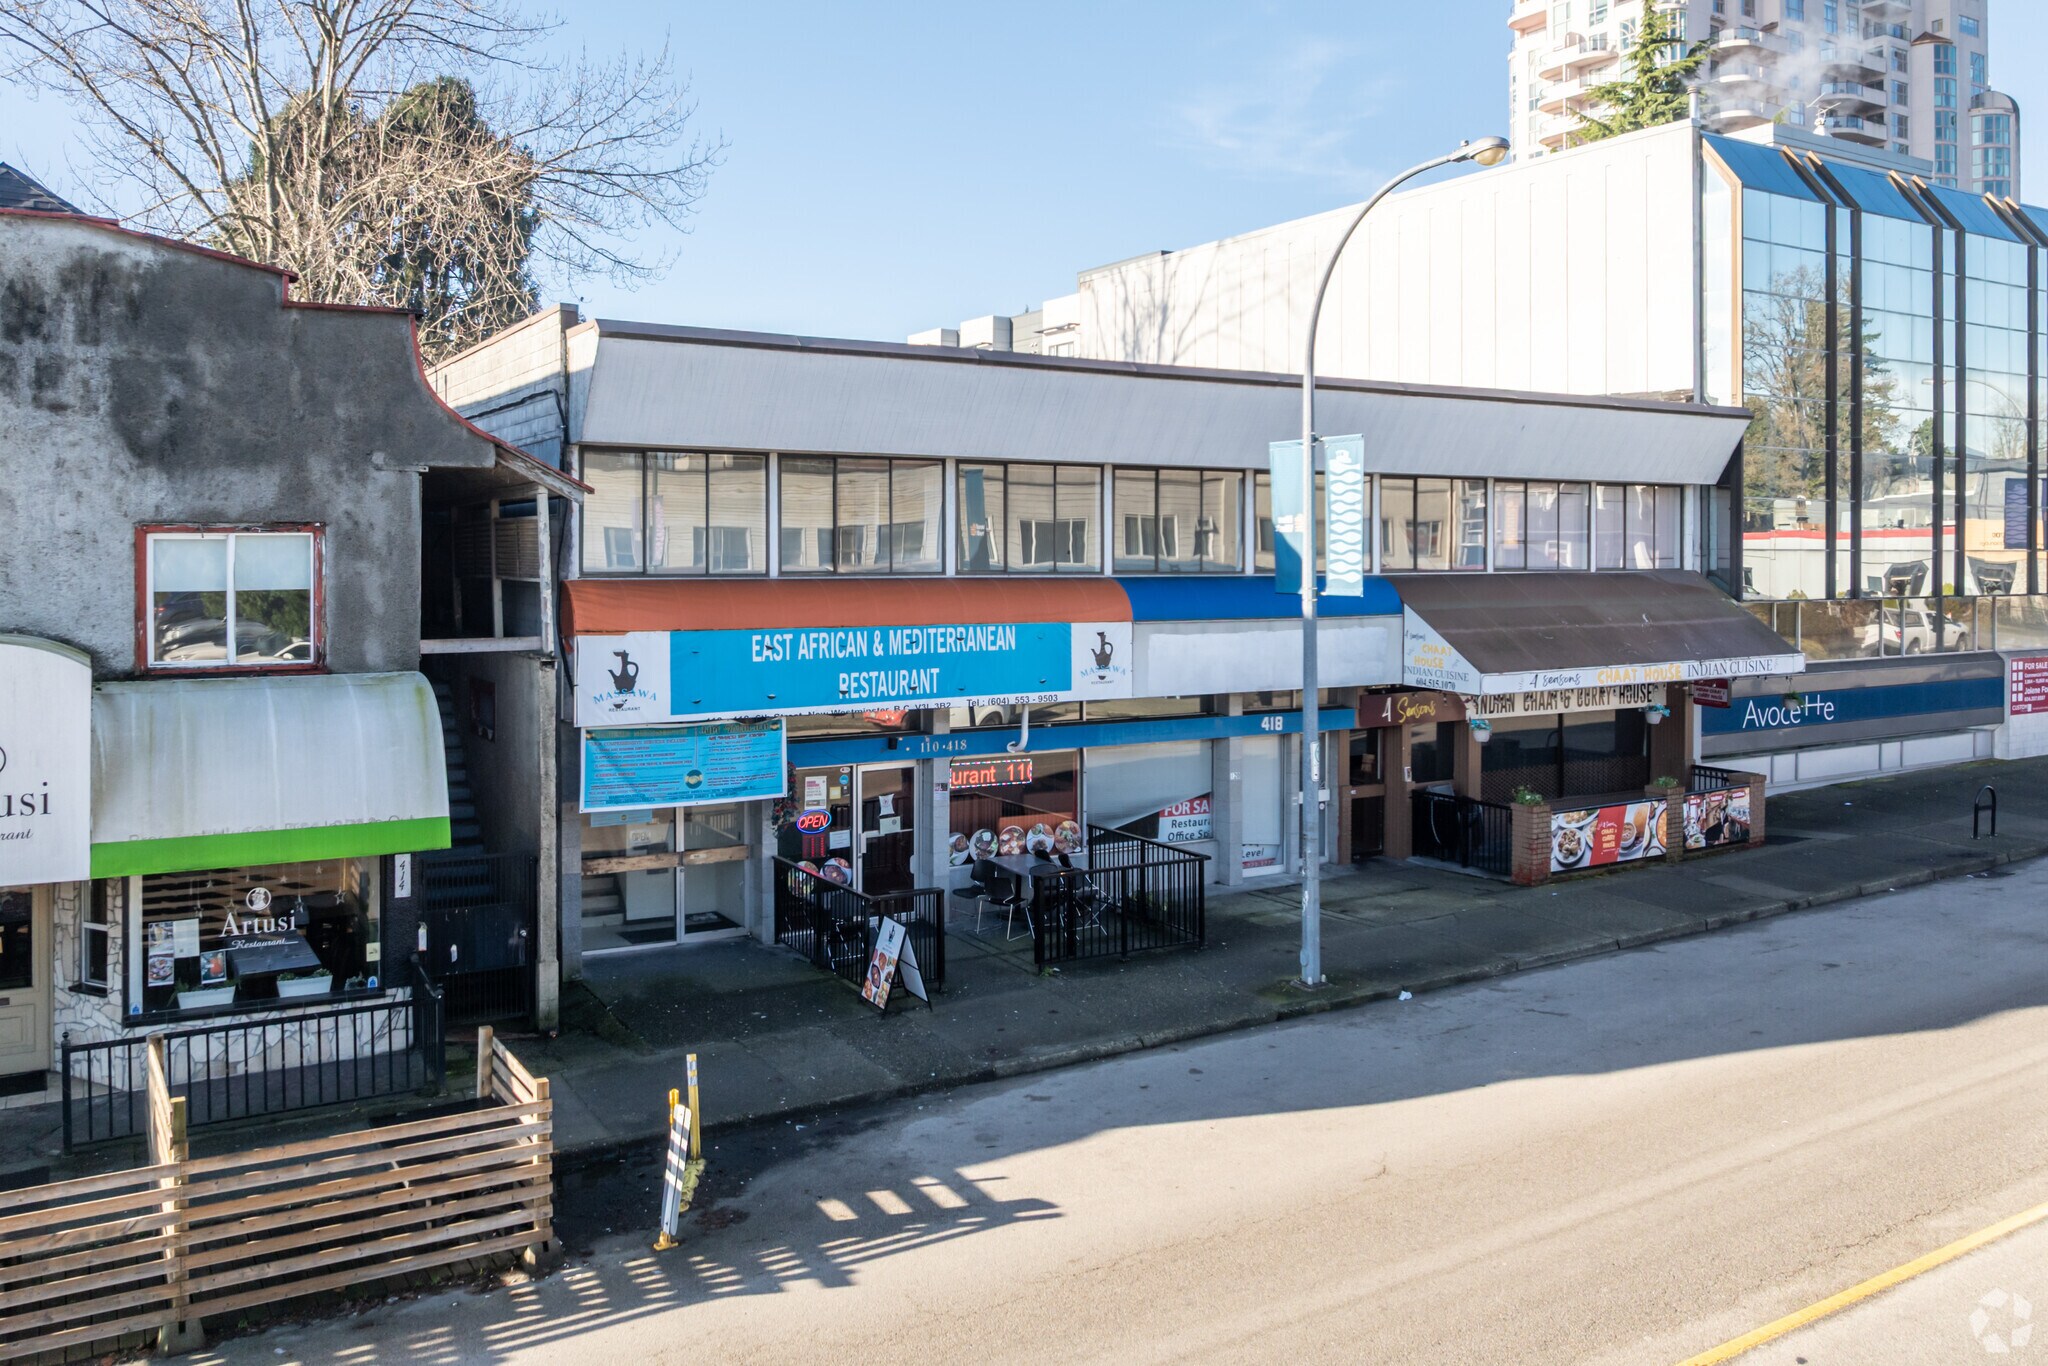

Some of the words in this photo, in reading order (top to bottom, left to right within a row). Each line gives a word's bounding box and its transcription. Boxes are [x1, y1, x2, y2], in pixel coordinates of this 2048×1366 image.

[752, 633, 793, 663] EAST
[798, 630, 868, 660] AFRICAN
[873, 629, 884, 656] &
[889, 625, 1016, 656] MEDITERRANEAN
[1422, 644, 1452, 656] CHAAT
[1414, 656, 1444, 669] HOUSE
[1404, 665, 1433, 677] INDIAN
[1435, 669, 1469, 681] CUISINE
[1597, 669, 1638, 684] CHAAT
[1644, 663, 1681, 680] HOUSE
[1688, 661, 1727, 678] INDIAN
[1730, 659, 1773, 674] CUISINE
[839, 668, 940, 699] RESTAURANT
[988, 697, 1009, 706] (604)
[1015, 695, 1030, 704] 553
[1038, 694, 1058, 702] 9503
[1619, 683, 1652, 704] HOUSE
[1382, 697, 1391, 722] 4
[1261, 716, 1283, 730] 418
[952, 766, 996, 784] urant
[1164, 802, 1190, 816] FOR
[799, 814, 828, 829] OPEN
[1168, 830, 1195, 841] Office
[218, 909, 297, 937] Artusi
[228, 937, 290, 949] Restaurant
